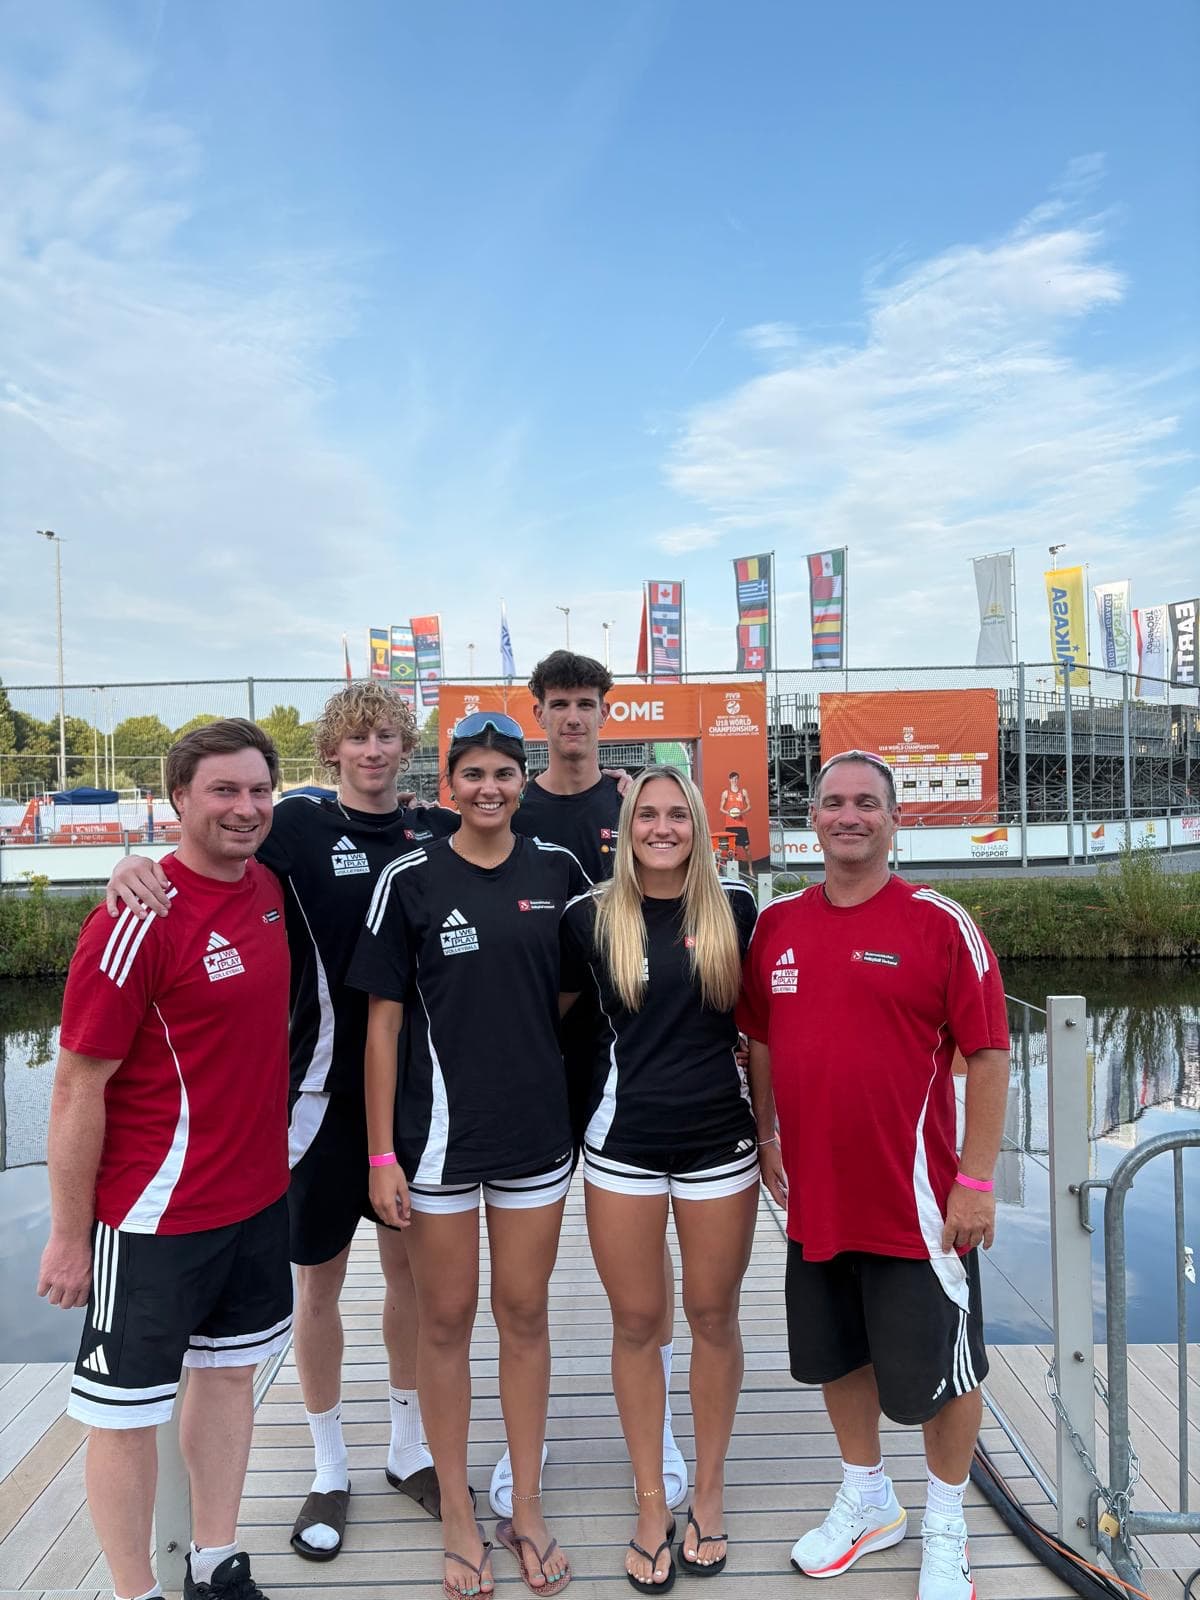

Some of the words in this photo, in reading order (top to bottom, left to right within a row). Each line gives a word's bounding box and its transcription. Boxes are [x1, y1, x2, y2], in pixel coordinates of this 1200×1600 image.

[716, 719, 729, 727] U18
[729, 718, 752, 726] WORLD
[708, 725, 759, 733] CHAMPIONSHIPS
[904, 743, 940, 751] CHAMPIONSHIPS
[971, 850, 1009, 858] TOPSPORT
[458, 928, 473, 936] WE
[454, 935, 476, 945] PLAY
[222, 949, 237, 958] WE
[220, 957, 240, 968] PLAY
[210, 966, 243, 980] VOLLEYBALL
[779, 977, 796, 985] PLAY
